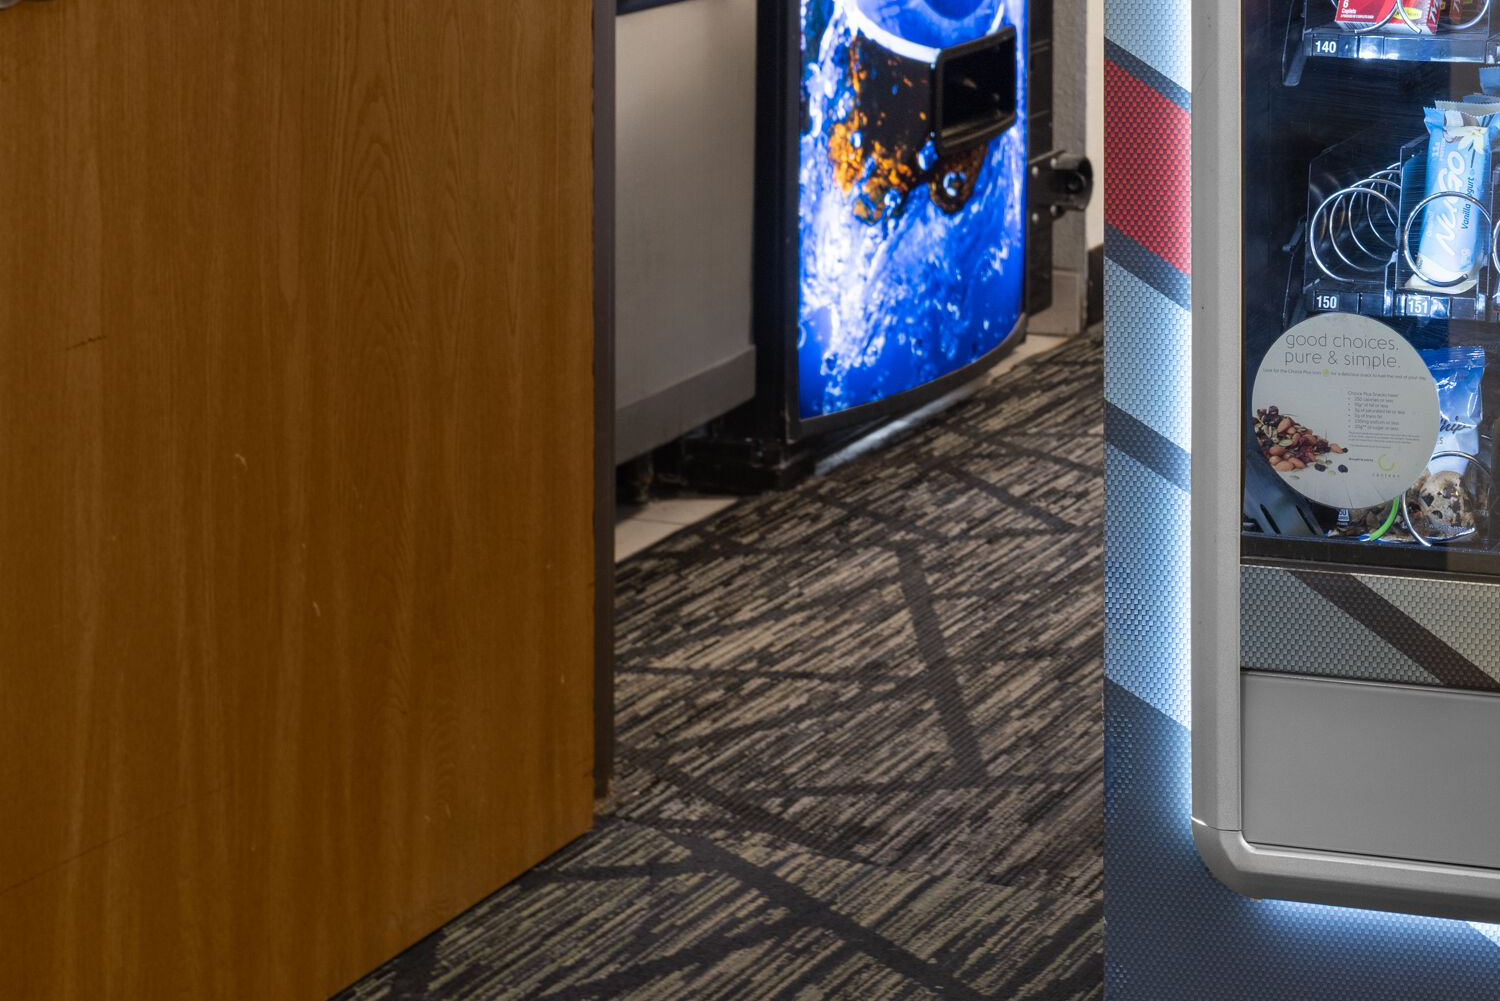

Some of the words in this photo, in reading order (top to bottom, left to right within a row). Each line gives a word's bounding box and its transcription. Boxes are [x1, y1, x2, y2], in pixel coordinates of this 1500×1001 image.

[1343, 0, 1349, 8] 6
[1315, 41, 1337, 53] 140
[1461, 203, 1472, 230] Vanilla
[1316, 296, 1337, 309] 150
[1408, 301, 1429, 314] 151
[1286, 333, 1327, 349] good
[1333, 334, 1399, 351] choices.
[1285, 352, 1322, 366] pure
[1328, 351, 1338, 365] &
[1344, 352, 1401, 370] simple.
